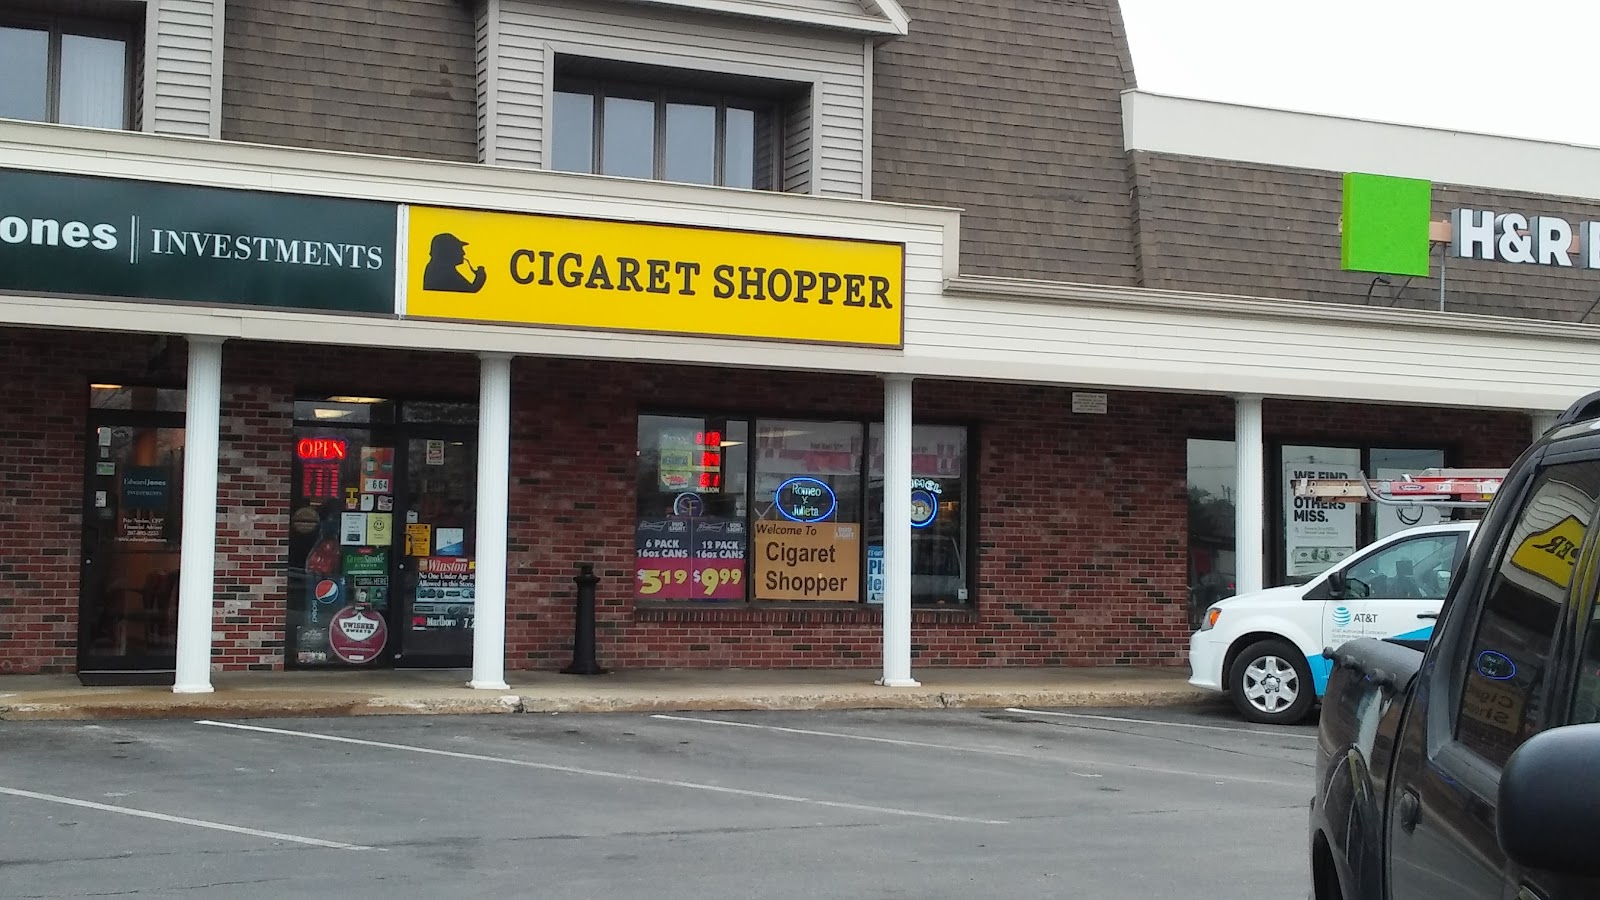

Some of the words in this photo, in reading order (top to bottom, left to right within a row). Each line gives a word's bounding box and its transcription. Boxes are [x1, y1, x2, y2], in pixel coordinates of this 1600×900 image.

[1452, 208, 1573, 267] H&R
[151, 228, 384, 270] INVESTMENTS
[509, 247, 700, 296] CIGARET
[713, 264, 893, 310] SHOPPER
[299, 438, 345, 460] OPEN
[1294, 471, 1315, 480] WE
[792, 482, 822, 497] Romeo
[791, 505, 819, 517] Julieta
[1294, 510, 1329, 523] MISS.
[756, 523, 803, 536] Welcome
[805, 525, 818, 536] To
[645, 538, 652, 548] 6
[654, 539, 679, 549] PACK
[701, 540, 713, 550] 12
[715, 541, 739, 551] PACK
[637, 549, 660, 558] 16oz
[661, 549, 688, 559] CANS
[696, 550, 717, 559] 16oz
[719, 550, 744, 559] CANS
[766, 541, 836, 567] Cigaret
[428, 559, 467, 572] Winston
[765, 570, 848, 596] Shopper
[427, 615, 457, 628] Marlboro
[1353, 613, 1379, 623] AT&T
[343, 622, 374, 630] SWISHER
